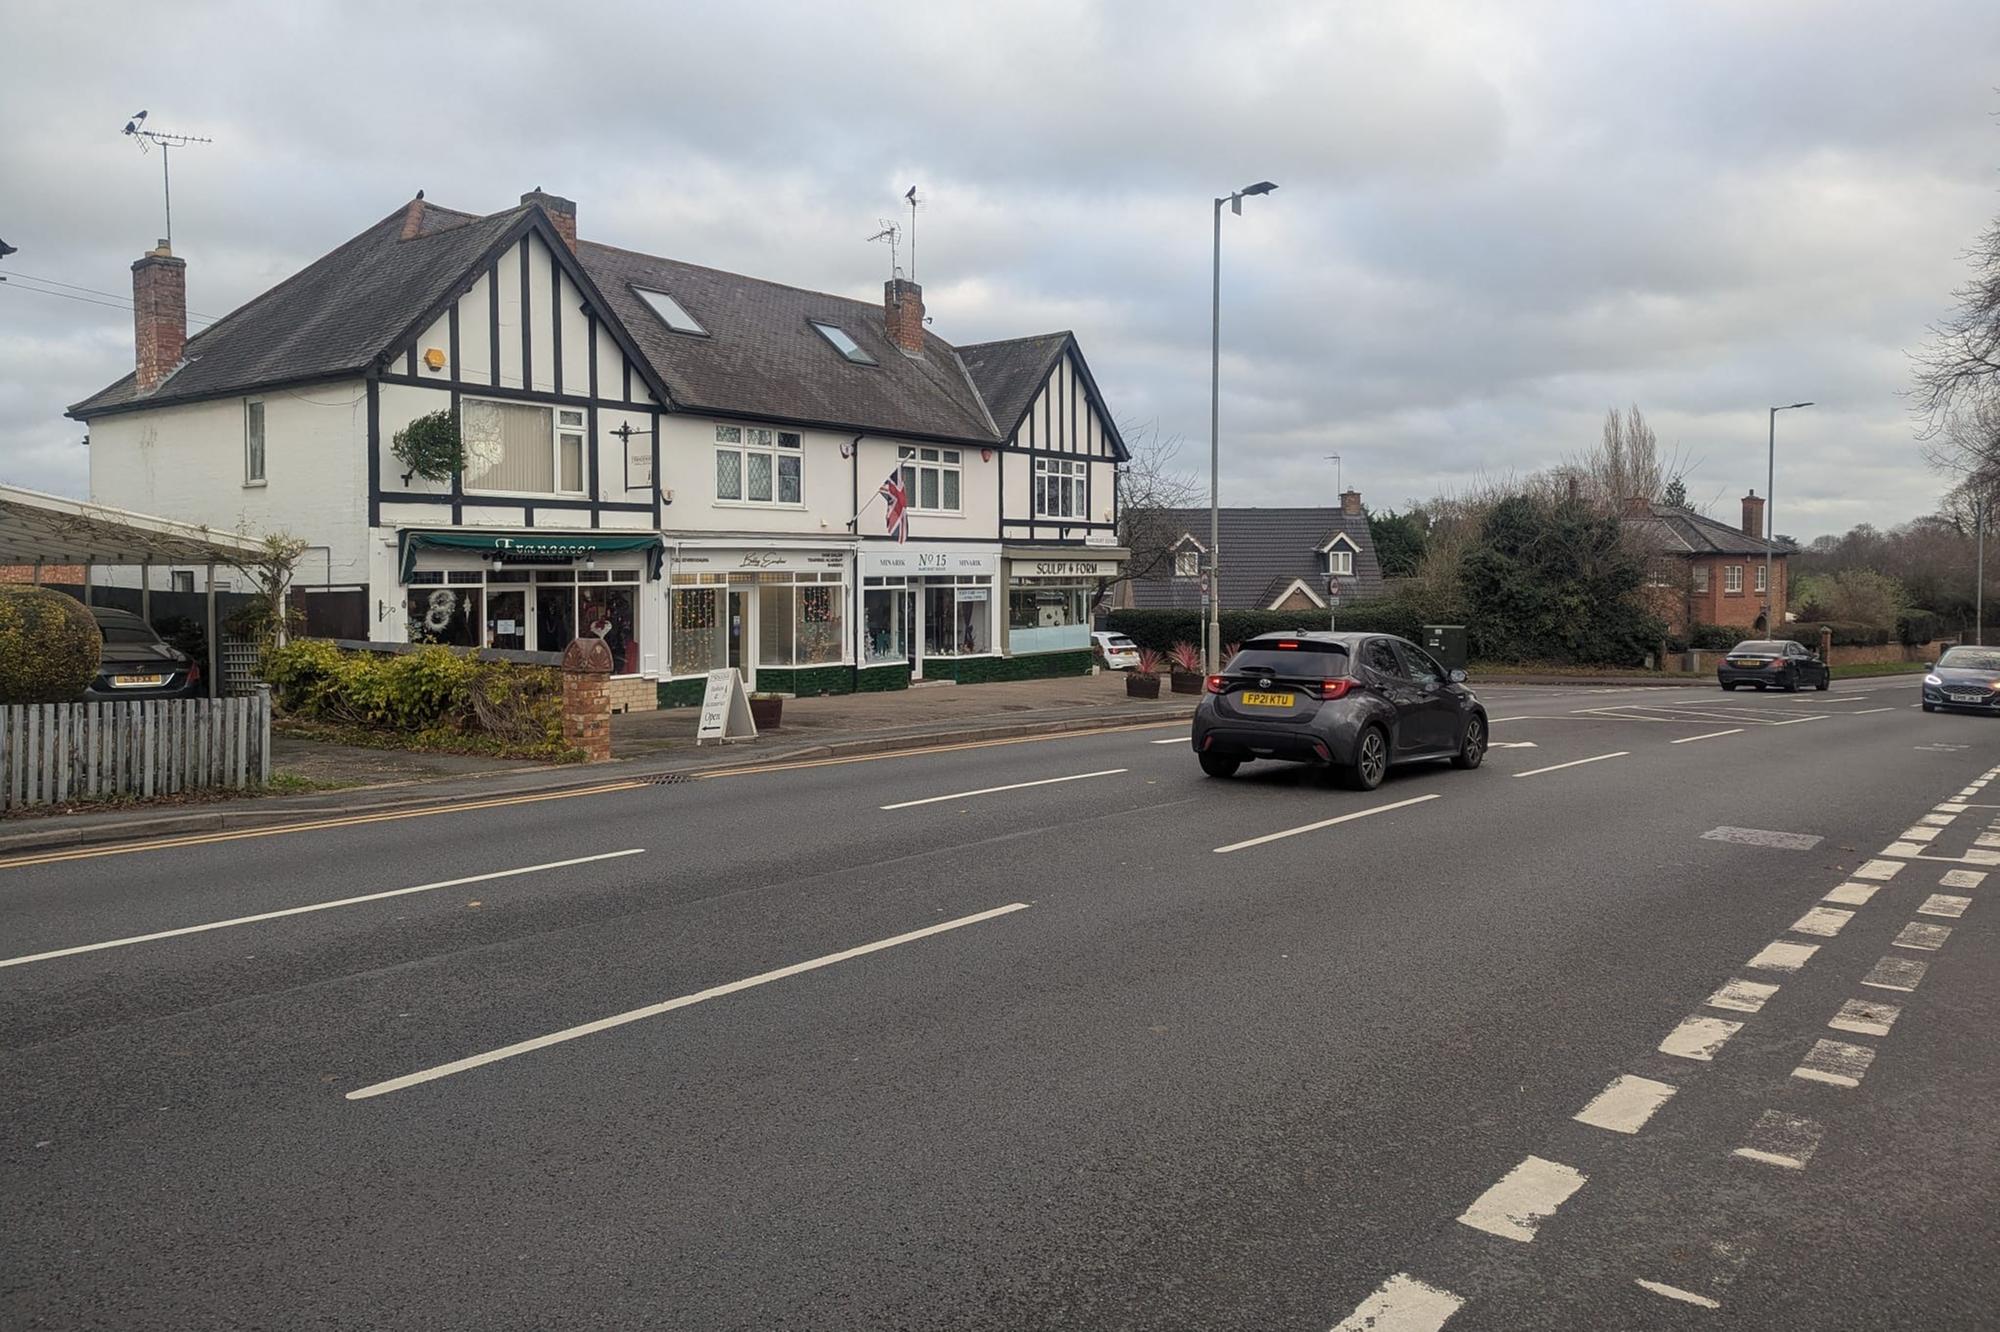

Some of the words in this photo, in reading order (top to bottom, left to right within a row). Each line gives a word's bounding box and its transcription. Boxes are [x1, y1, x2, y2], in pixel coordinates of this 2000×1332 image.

[935, 554, 947, 566] 15
[1036, 562, 1066, 575] SCULPT
[1075, 562, 1098, 574] FORM
[1247, 693, 1269, 704] FP21
[1269, 694, 1289, 705] KTU
[704, 712, 721, 725] Open
